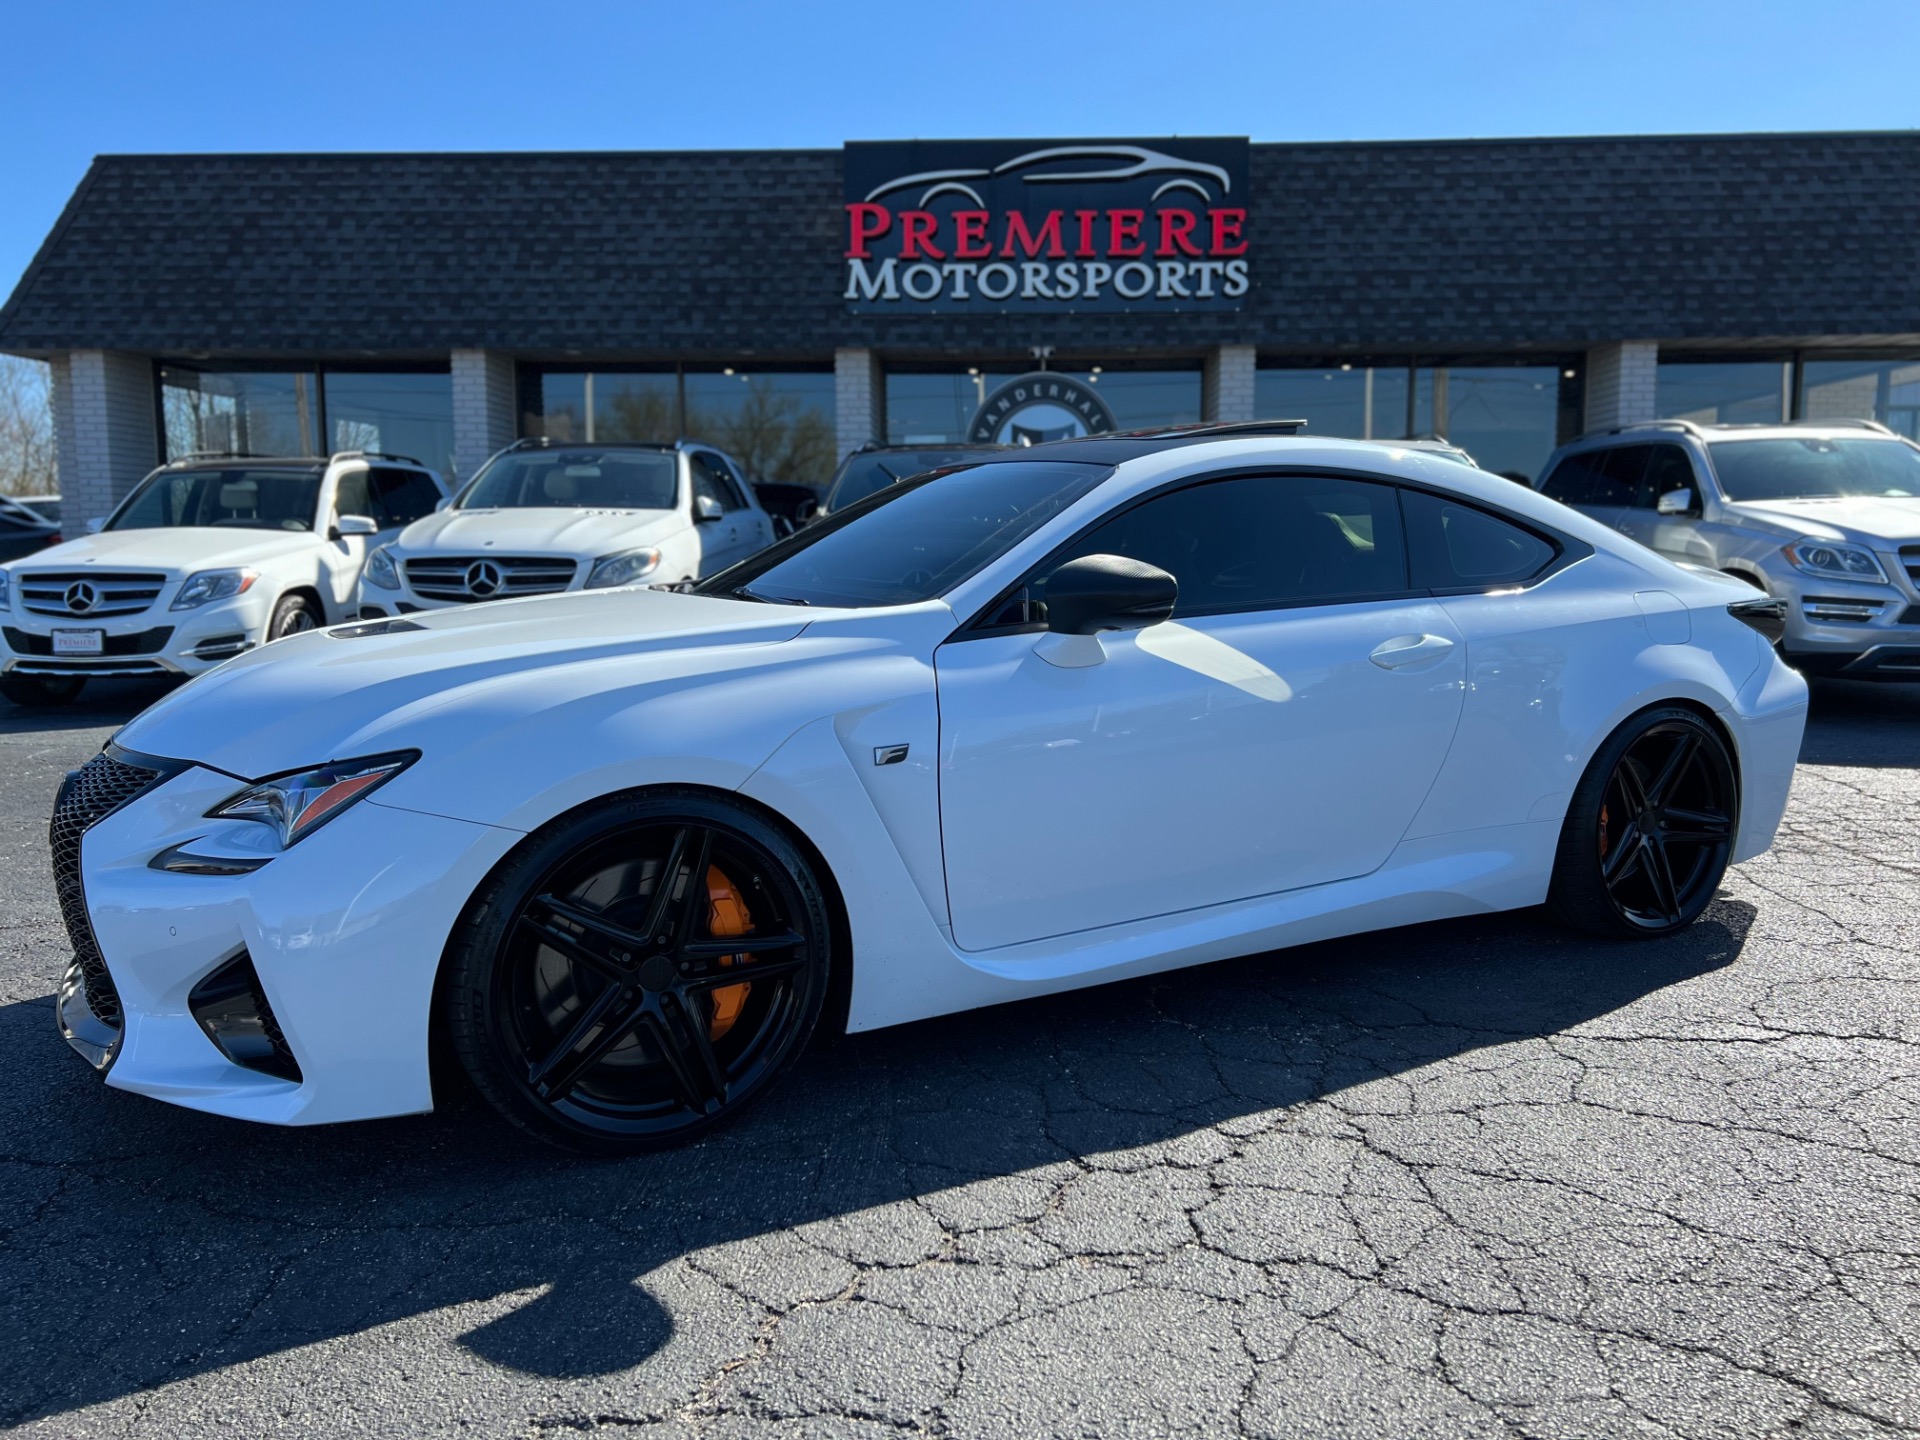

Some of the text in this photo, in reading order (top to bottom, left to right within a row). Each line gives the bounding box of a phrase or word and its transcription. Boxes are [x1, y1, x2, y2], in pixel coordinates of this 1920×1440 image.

[844, 203, 1249, 259] PREMIERE
[844, 258, 1250, 300] MOTORSPORTS
[977, 383, 1107, 439] VANDERHAL
